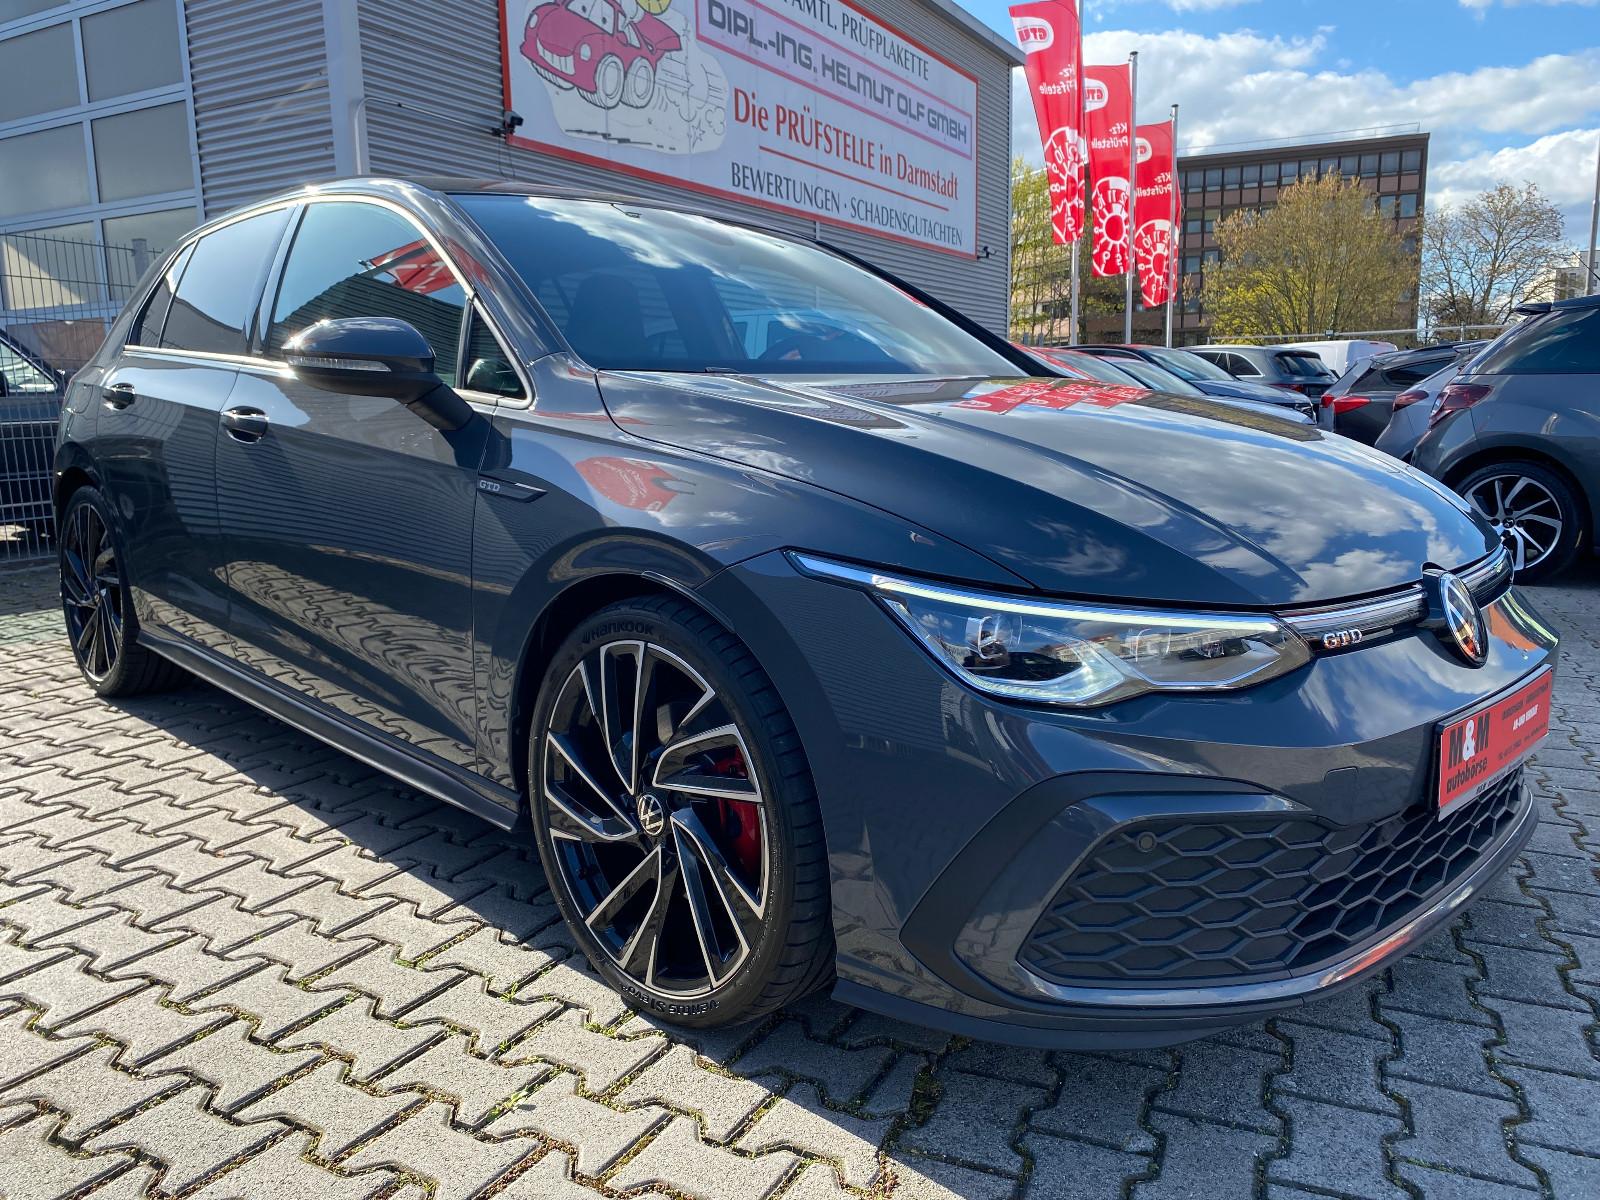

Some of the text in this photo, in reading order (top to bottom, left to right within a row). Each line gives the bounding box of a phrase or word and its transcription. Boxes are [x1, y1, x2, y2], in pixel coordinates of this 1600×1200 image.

[842, 12, 929, 81] PRÜFPLAKETTE
[822, 53, 894, 108] HELMUT
[897, 92, 925, 122] OLF
[734, 87, 959, 200] Die PRÜFSTELLE in Darmstadt
[731, 161, 963, 246] BEWERTUNGEN SCHADENSGUTACHTEN
[479, 480, 501, 492] GTD
[1323, 628, 1363, 649] GTD
[1448, 711, 1491, 770] M&M
[1446, 757, 1488, 794] autobörse
